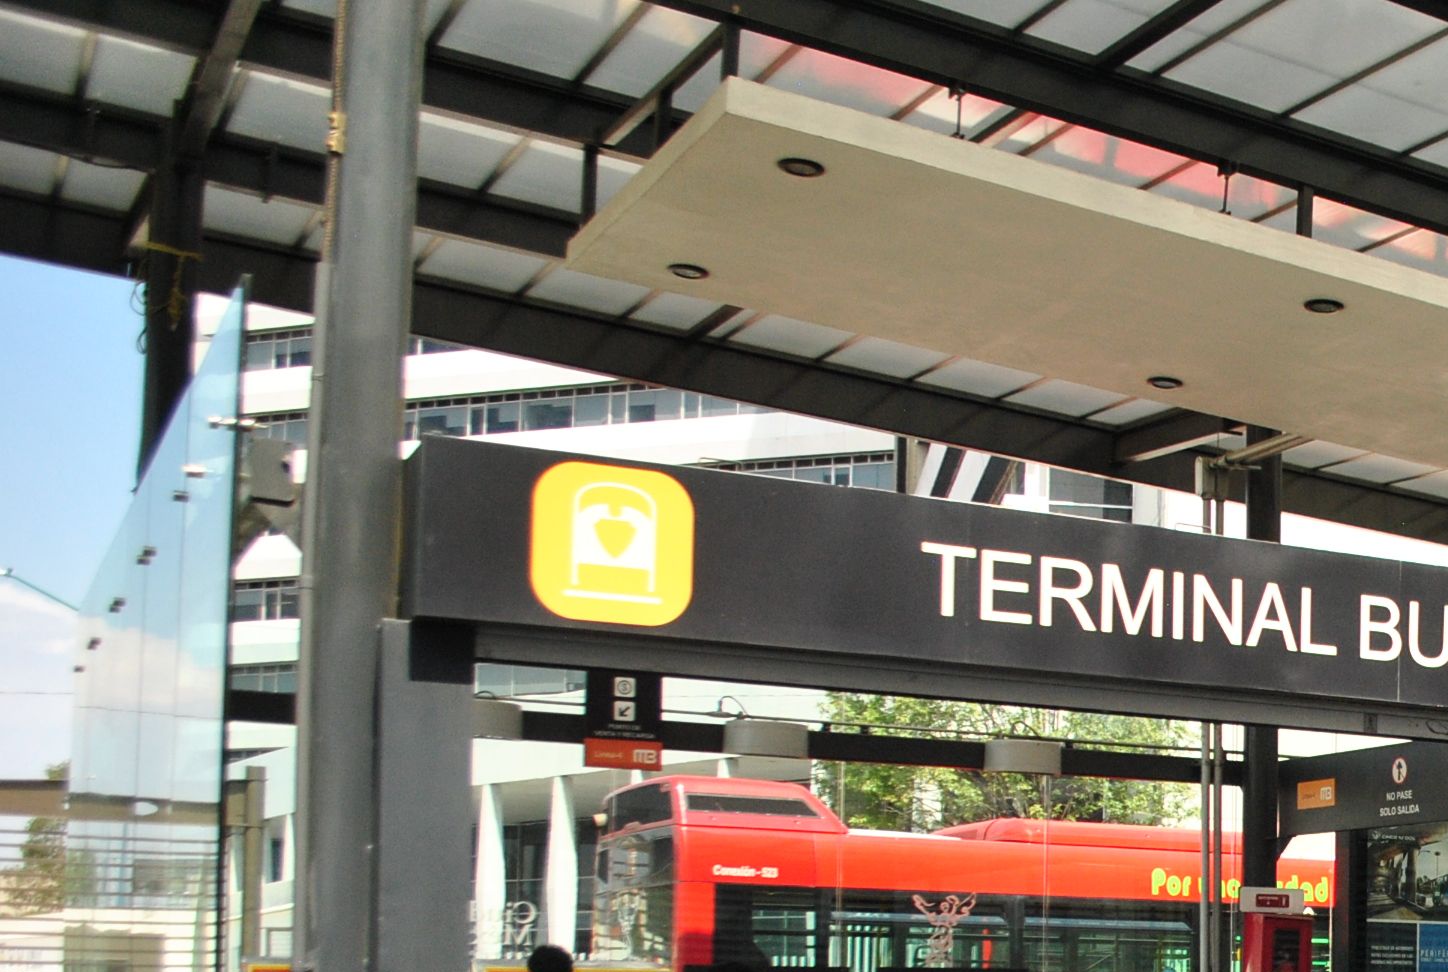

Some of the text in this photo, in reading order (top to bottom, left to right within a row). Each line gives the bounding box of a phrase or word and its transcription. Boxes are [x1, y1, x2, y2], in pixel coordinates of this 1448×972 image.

[921, 541, 1338, 656] TERMINAL
[1386, 790, 1413, 801] NO PASE
[1380, 804, 1420, 816] SOLO SALIDA
[1152, 868, 1191, 896] Por
